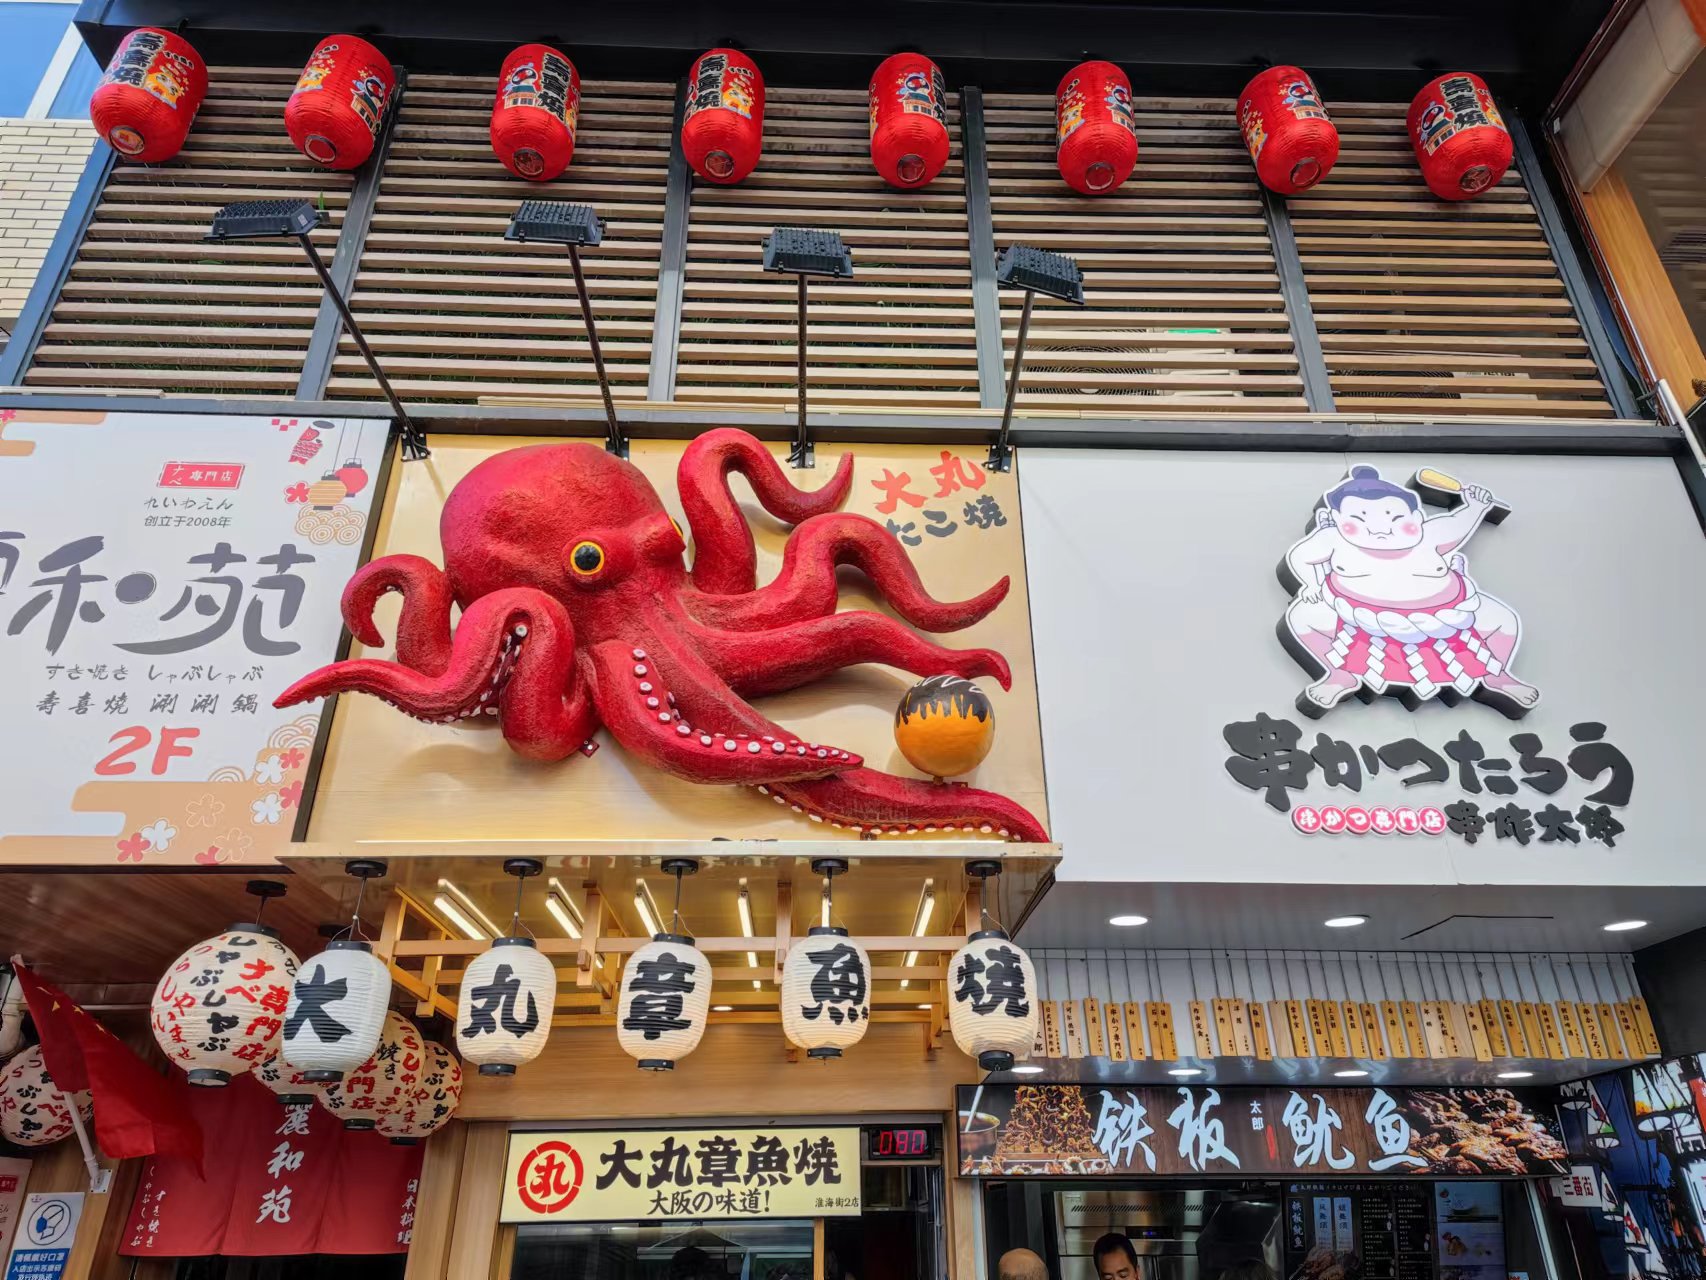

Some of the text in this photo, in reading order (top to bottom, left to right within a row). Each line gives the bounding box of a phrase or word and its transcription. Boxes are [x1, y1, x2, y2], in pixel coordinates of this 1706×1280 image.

[871, 450, 986, 515] 大丸
[144, 515, 232, 528] 创立于2008年
[0, 531, 316, 657] 和苑
[45, 663, 264, 684] すき焼き しゃぶしゃぶ
[94, 725, 200, 776] 2F
[1222, 712, 1635, 812] 串かつたろう
[283, 964, 353, 1043] 大
[460, 963, 540, 1038] 丸
[622, 952, 696, 1040] 章
[801, 942, 870, 1025] 魚
[1250, 1100, 1264, 1131] 太郎
[530, 1154, 570, 1199] 丸
